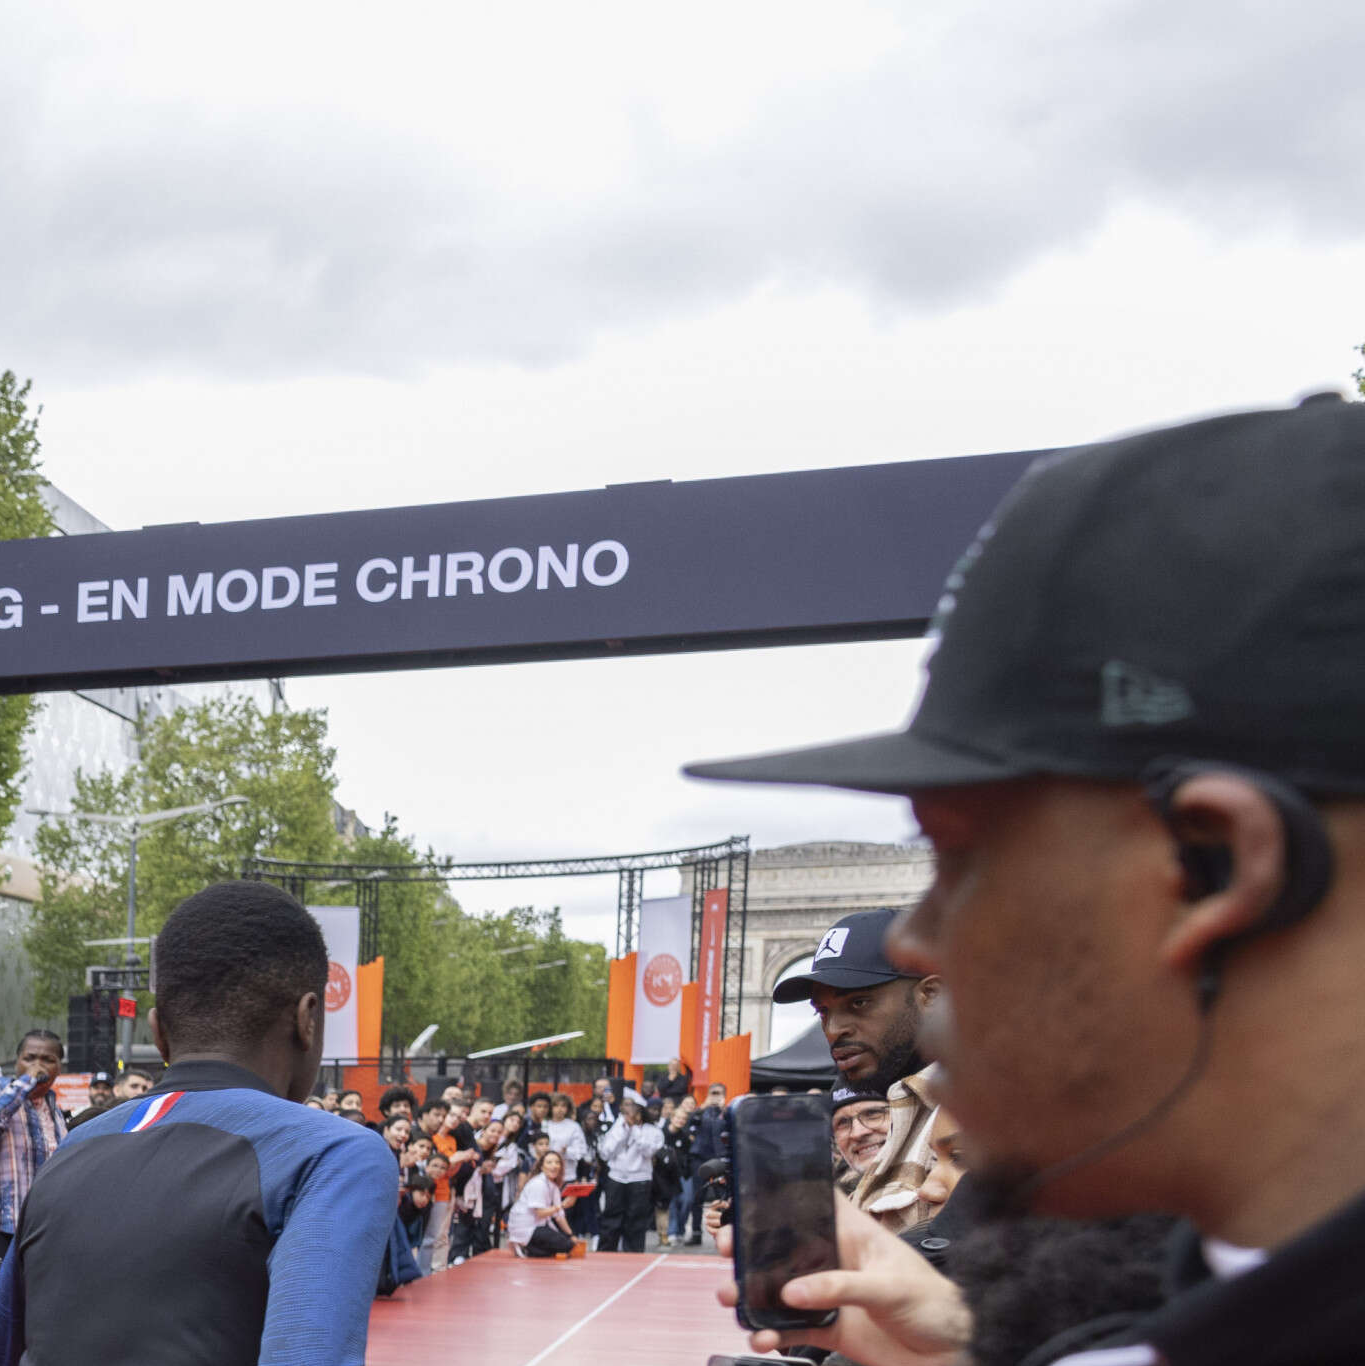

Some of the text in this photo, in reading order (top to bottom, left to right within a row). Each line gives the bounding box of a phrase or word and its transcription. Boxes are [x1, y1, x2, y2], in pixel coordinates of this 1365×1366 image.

[40, 604, 59, 615] -
[76, 577, 149, 623] EN
[166, 562, 339, 617] MODE
[355, 539, 630, 603] CHRONO
